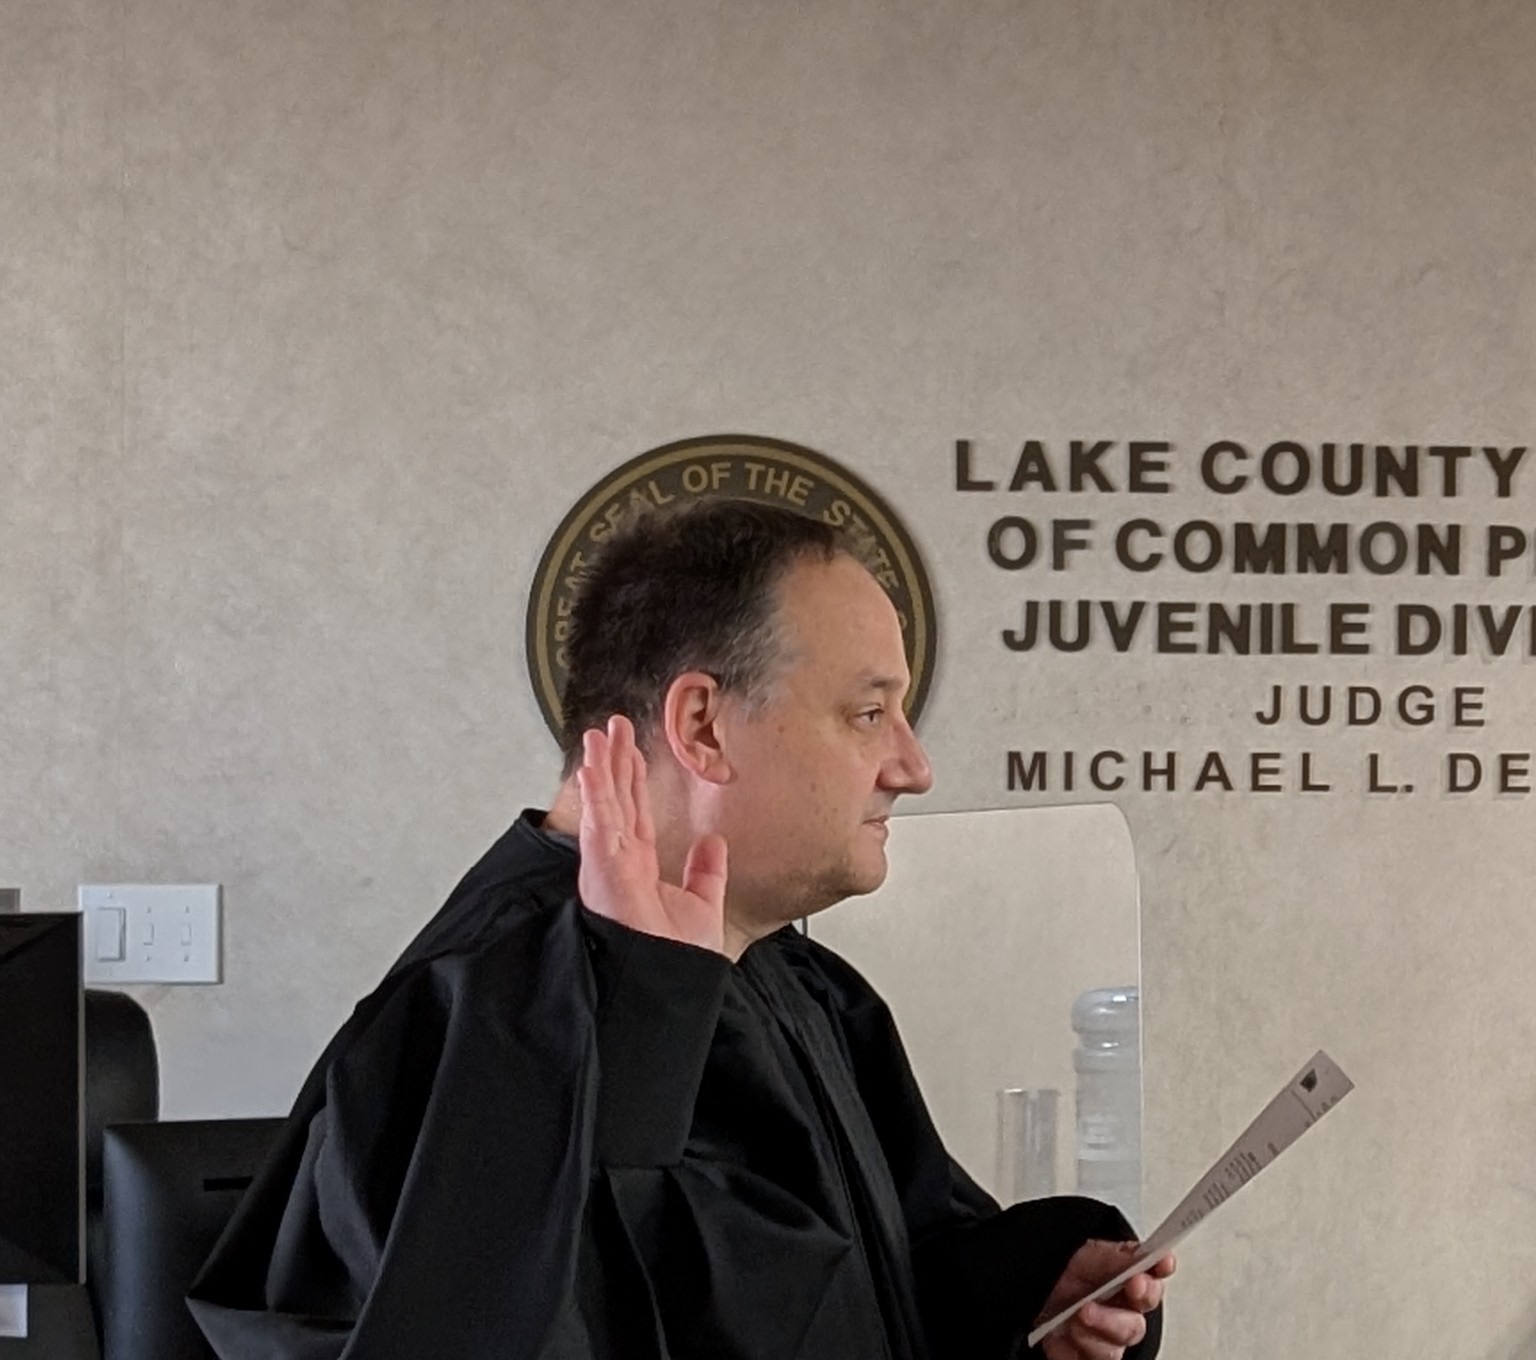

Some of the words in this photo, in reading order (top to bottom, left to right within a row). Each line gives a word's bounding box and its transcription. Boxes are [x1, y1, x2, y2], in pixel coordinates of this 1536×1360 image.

[682, 462, 731, 493] OF
[744, 462, 815, 507] THE
[955, 439, 1171, 494] LAKE
[1200, 440, 1528, 499] COUNTY
[987, 516, 1093, 572] OF
[1115, 518, 1462, 576] COMMON
[1002, 599, 1371, 656] JUVENILE
[1255, 685, 1486, 727] JUDGE
[1007, 750, 1331, 792] MICHAEL
[1369, 753, 1414, 794] L.
